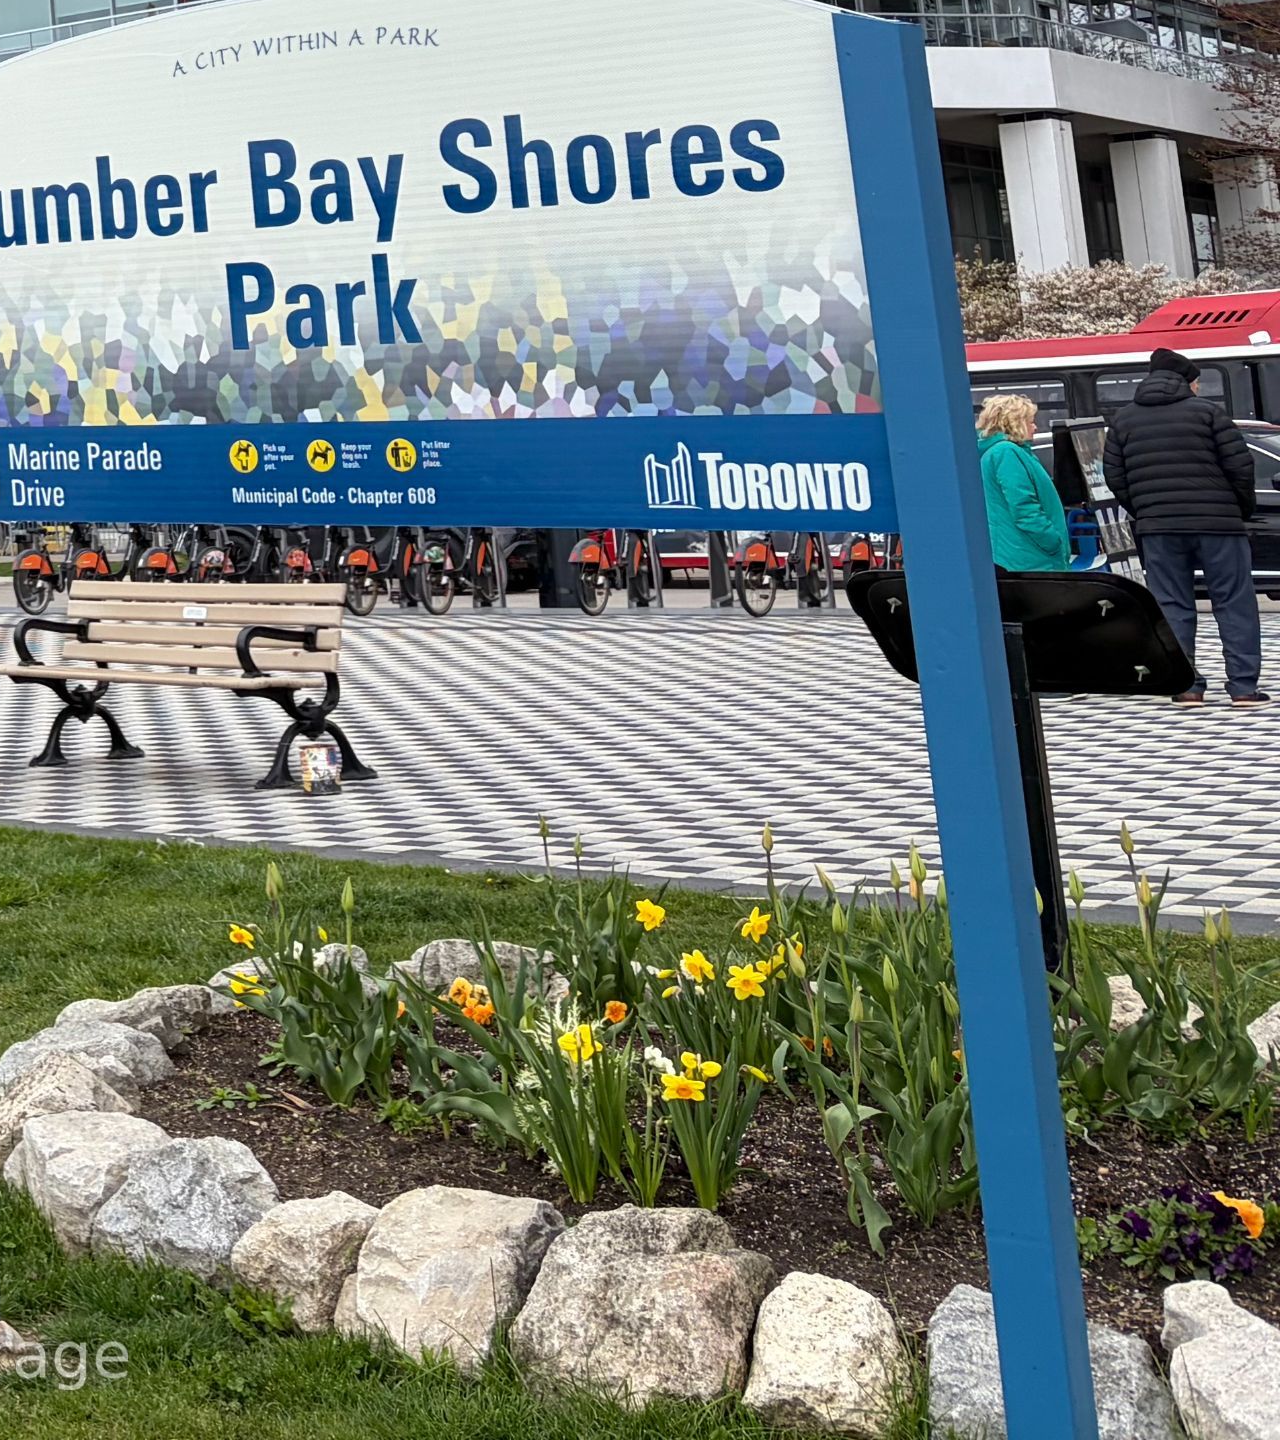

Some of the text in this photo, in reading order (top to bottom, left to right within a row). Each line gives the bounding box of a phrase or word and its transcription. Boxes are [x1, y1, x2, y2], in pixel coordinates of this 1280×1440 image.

[172, 26, 440, 78] A CITY WITHIN A PARK
[248, 139, 404, 242] Bay
[439, 114, 785, 214] Shores
[225, 253, 424, 350] Park
[8, 442, 162, 471] Marine Parade
[697, 452, 872, 511] TORONTO
[11, 479, 65, 507] Drive
[232, 487, 436, 508] Municipal Code Chapter 608
